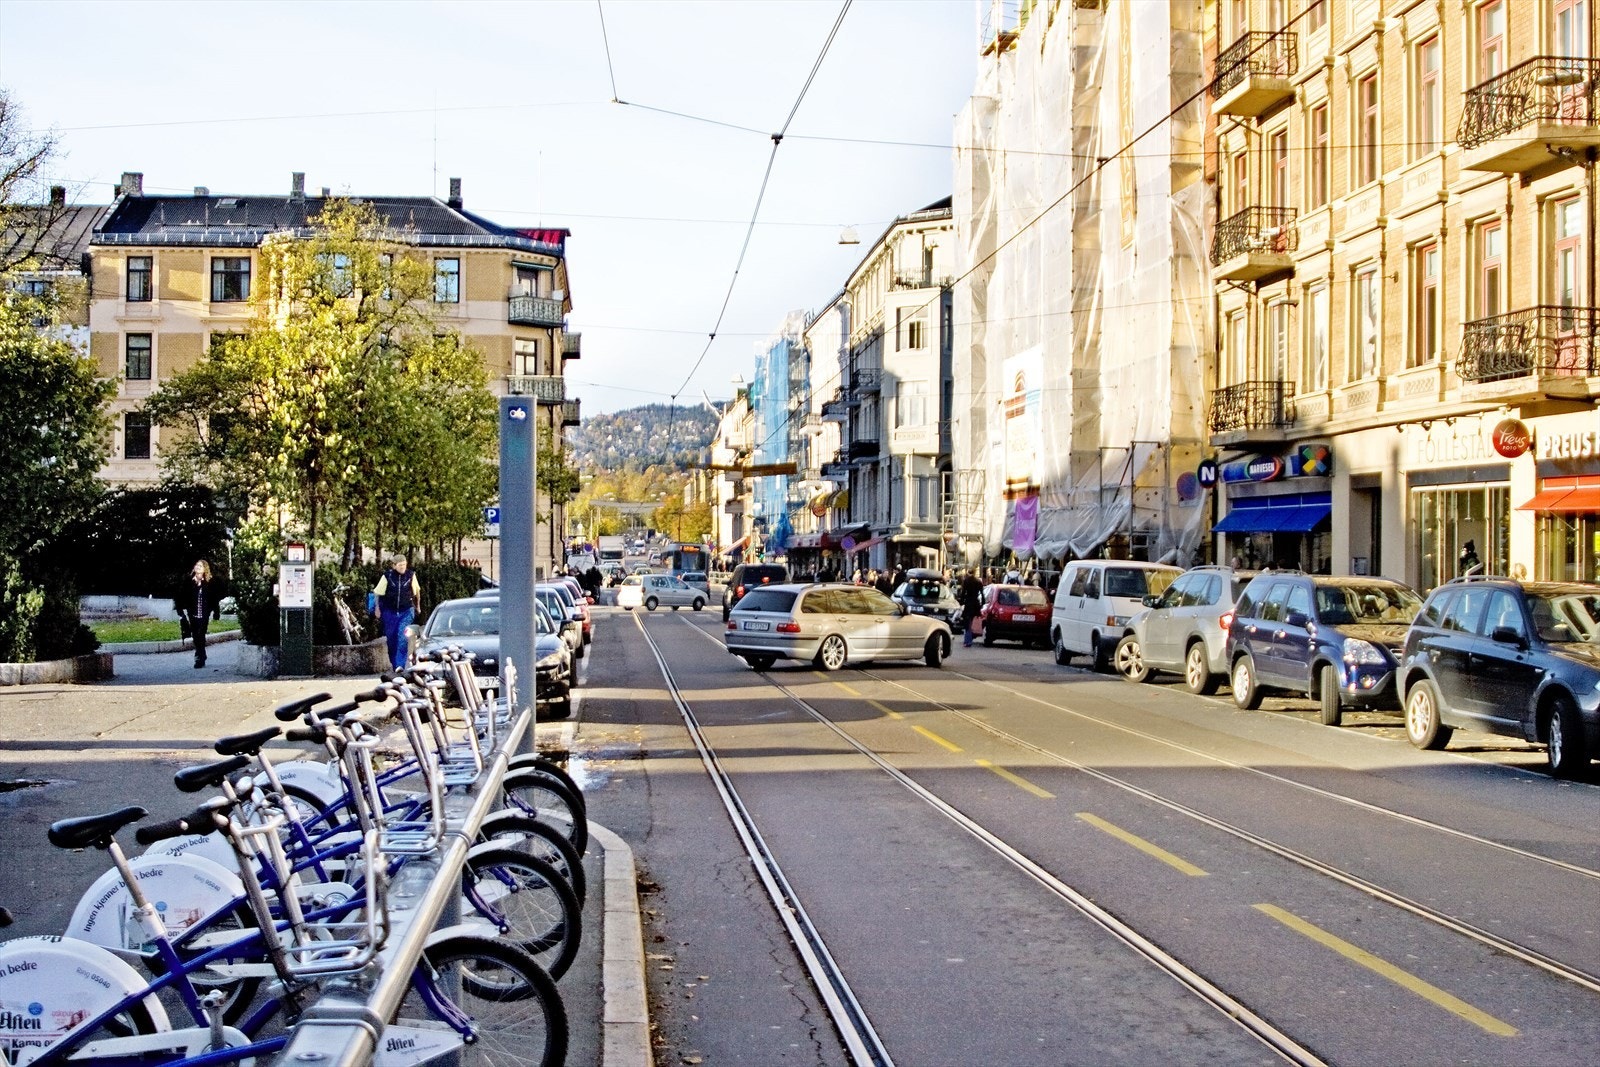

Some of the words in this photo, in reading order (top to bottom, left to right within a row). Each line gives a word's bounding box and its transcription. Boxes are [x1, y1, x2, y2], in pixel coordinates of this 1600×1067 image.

[1499, 425, 1526, 448] Preus
[1417, 433, 1495, 464] FOLLESTAD
[1542, 432, 1592, 459] PREUS
[1201, 466, 1215, 481] N
[1249, 462, 1275, 475] NARVESEN
[487, 508, 497, 520] P
[189, 836, 210, 847] bedre
[83, 909, 98, 933] Ingen
[97, 886, 120, 910] kjenner
[140, 868, 164, 880] bedre
[7, 961, 38, 975] bedre
[91, 973, 111, 989] 05040
